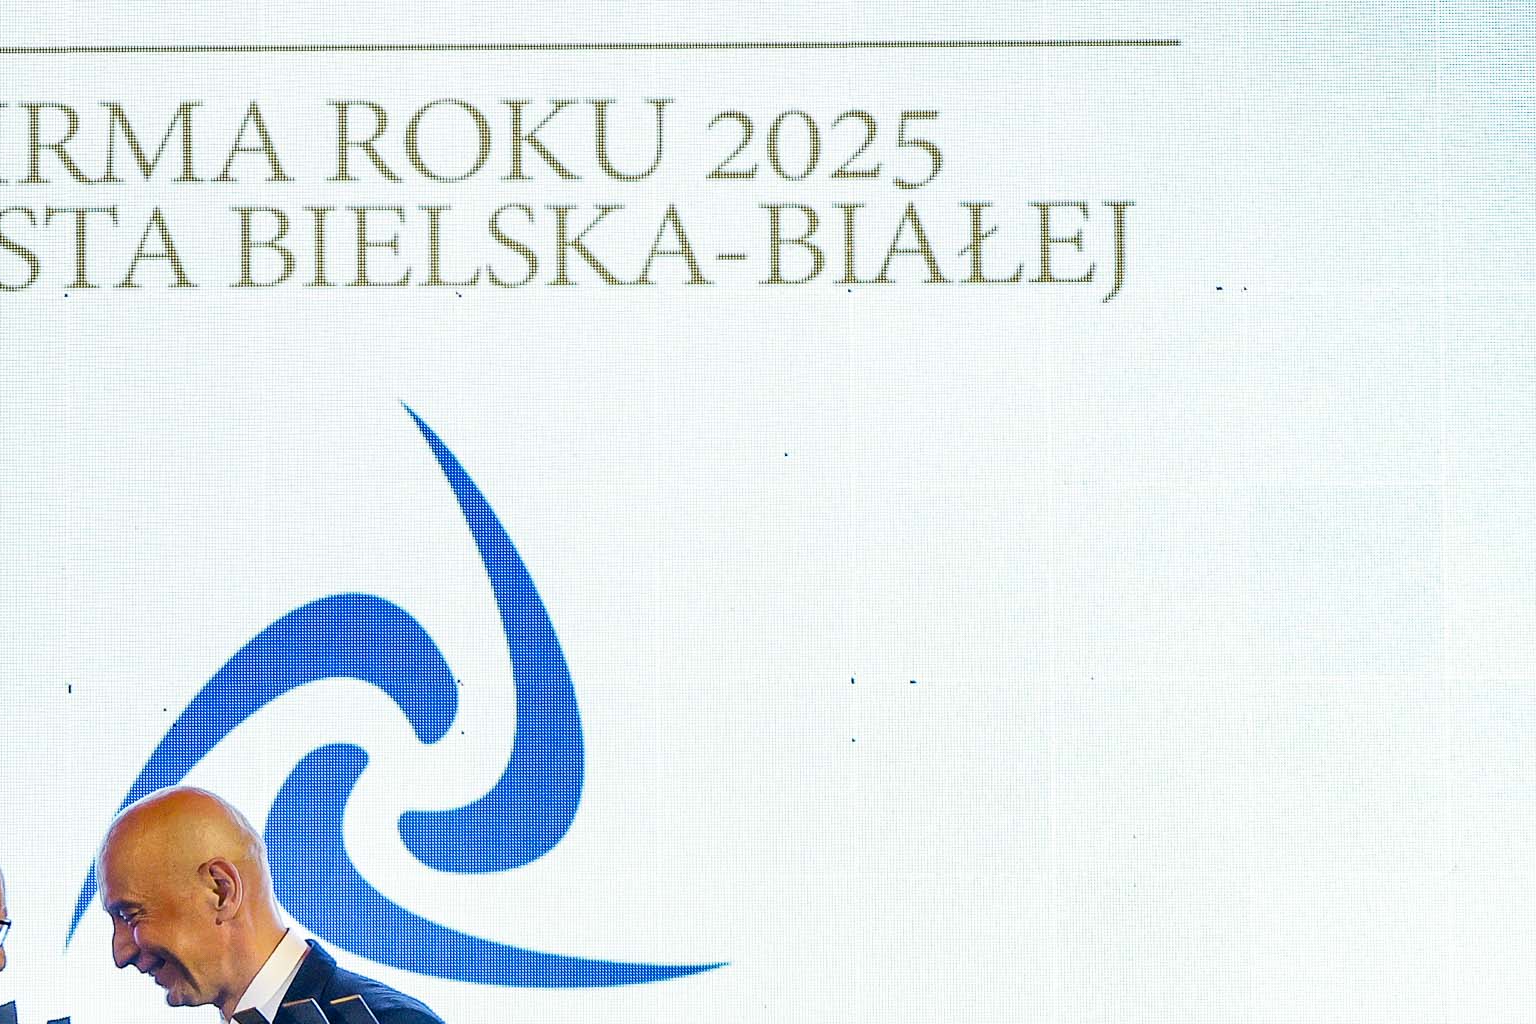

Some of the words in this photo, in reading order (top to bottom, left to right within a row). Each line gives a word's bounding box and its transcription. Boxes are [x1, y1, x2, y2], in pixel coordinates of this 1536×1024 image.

[326, 97, 677, 184] ROKU
[705, 109, 944, 190] 2025
[228, 200, 1137, 304] BIELSKA-BIAŁEJ
